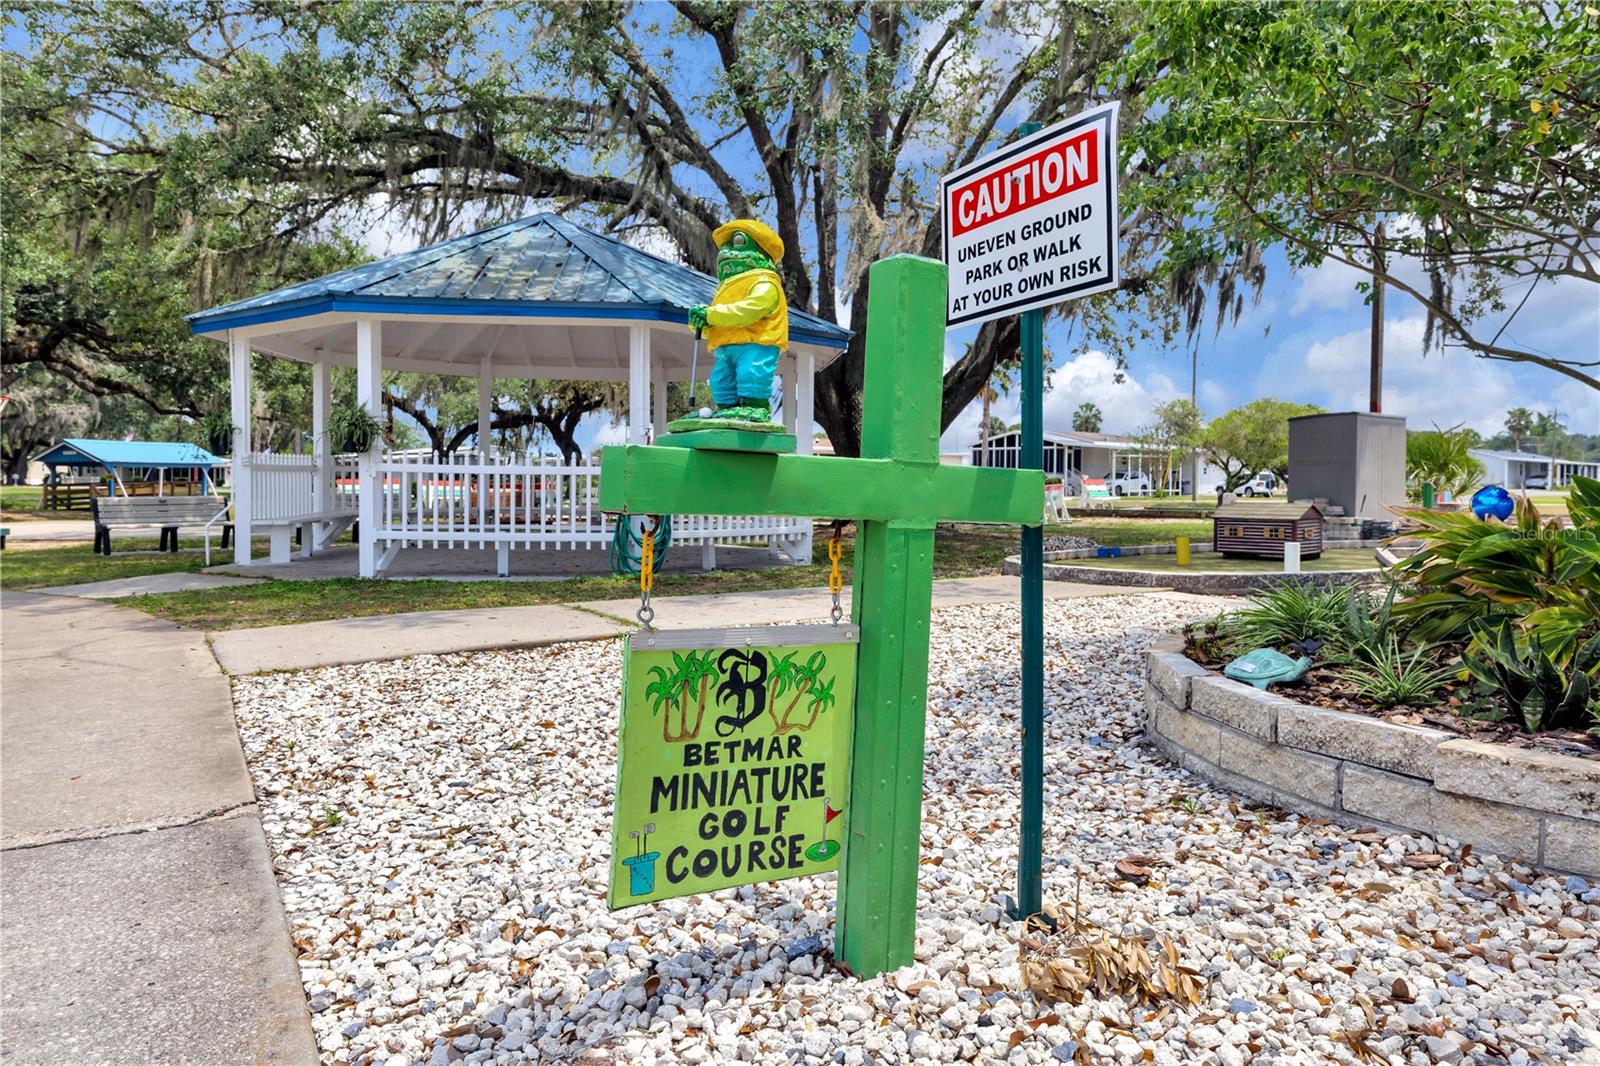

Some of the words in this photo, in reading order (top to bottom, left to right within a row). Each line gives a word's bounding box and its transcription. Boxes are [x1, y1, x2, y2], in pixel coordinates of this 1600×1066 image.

[958, 139, 1089, 228] CAUTION
[958, 229, 1016, 263] UNEVEN
[1021, 203, 1092, 240] GROUND
[952, 296, 968, 313] AT
[973, 282, 1013, 307] YOUR
[1018, 270, 1054, 293] OWN
[1060, 256, 1102, 282] RISK
[966, 260, 1002, 285] PARK
[1007, 252, 1029, 271] OR
[1034, 234, 1082, 263] WALK
[684, 734, 803, 767] BETMAR
[650, 762, 826, 814] MINIATURE
[700, 805, 790, 840] GOLF
[666, 833, 805, 884] COURSE
